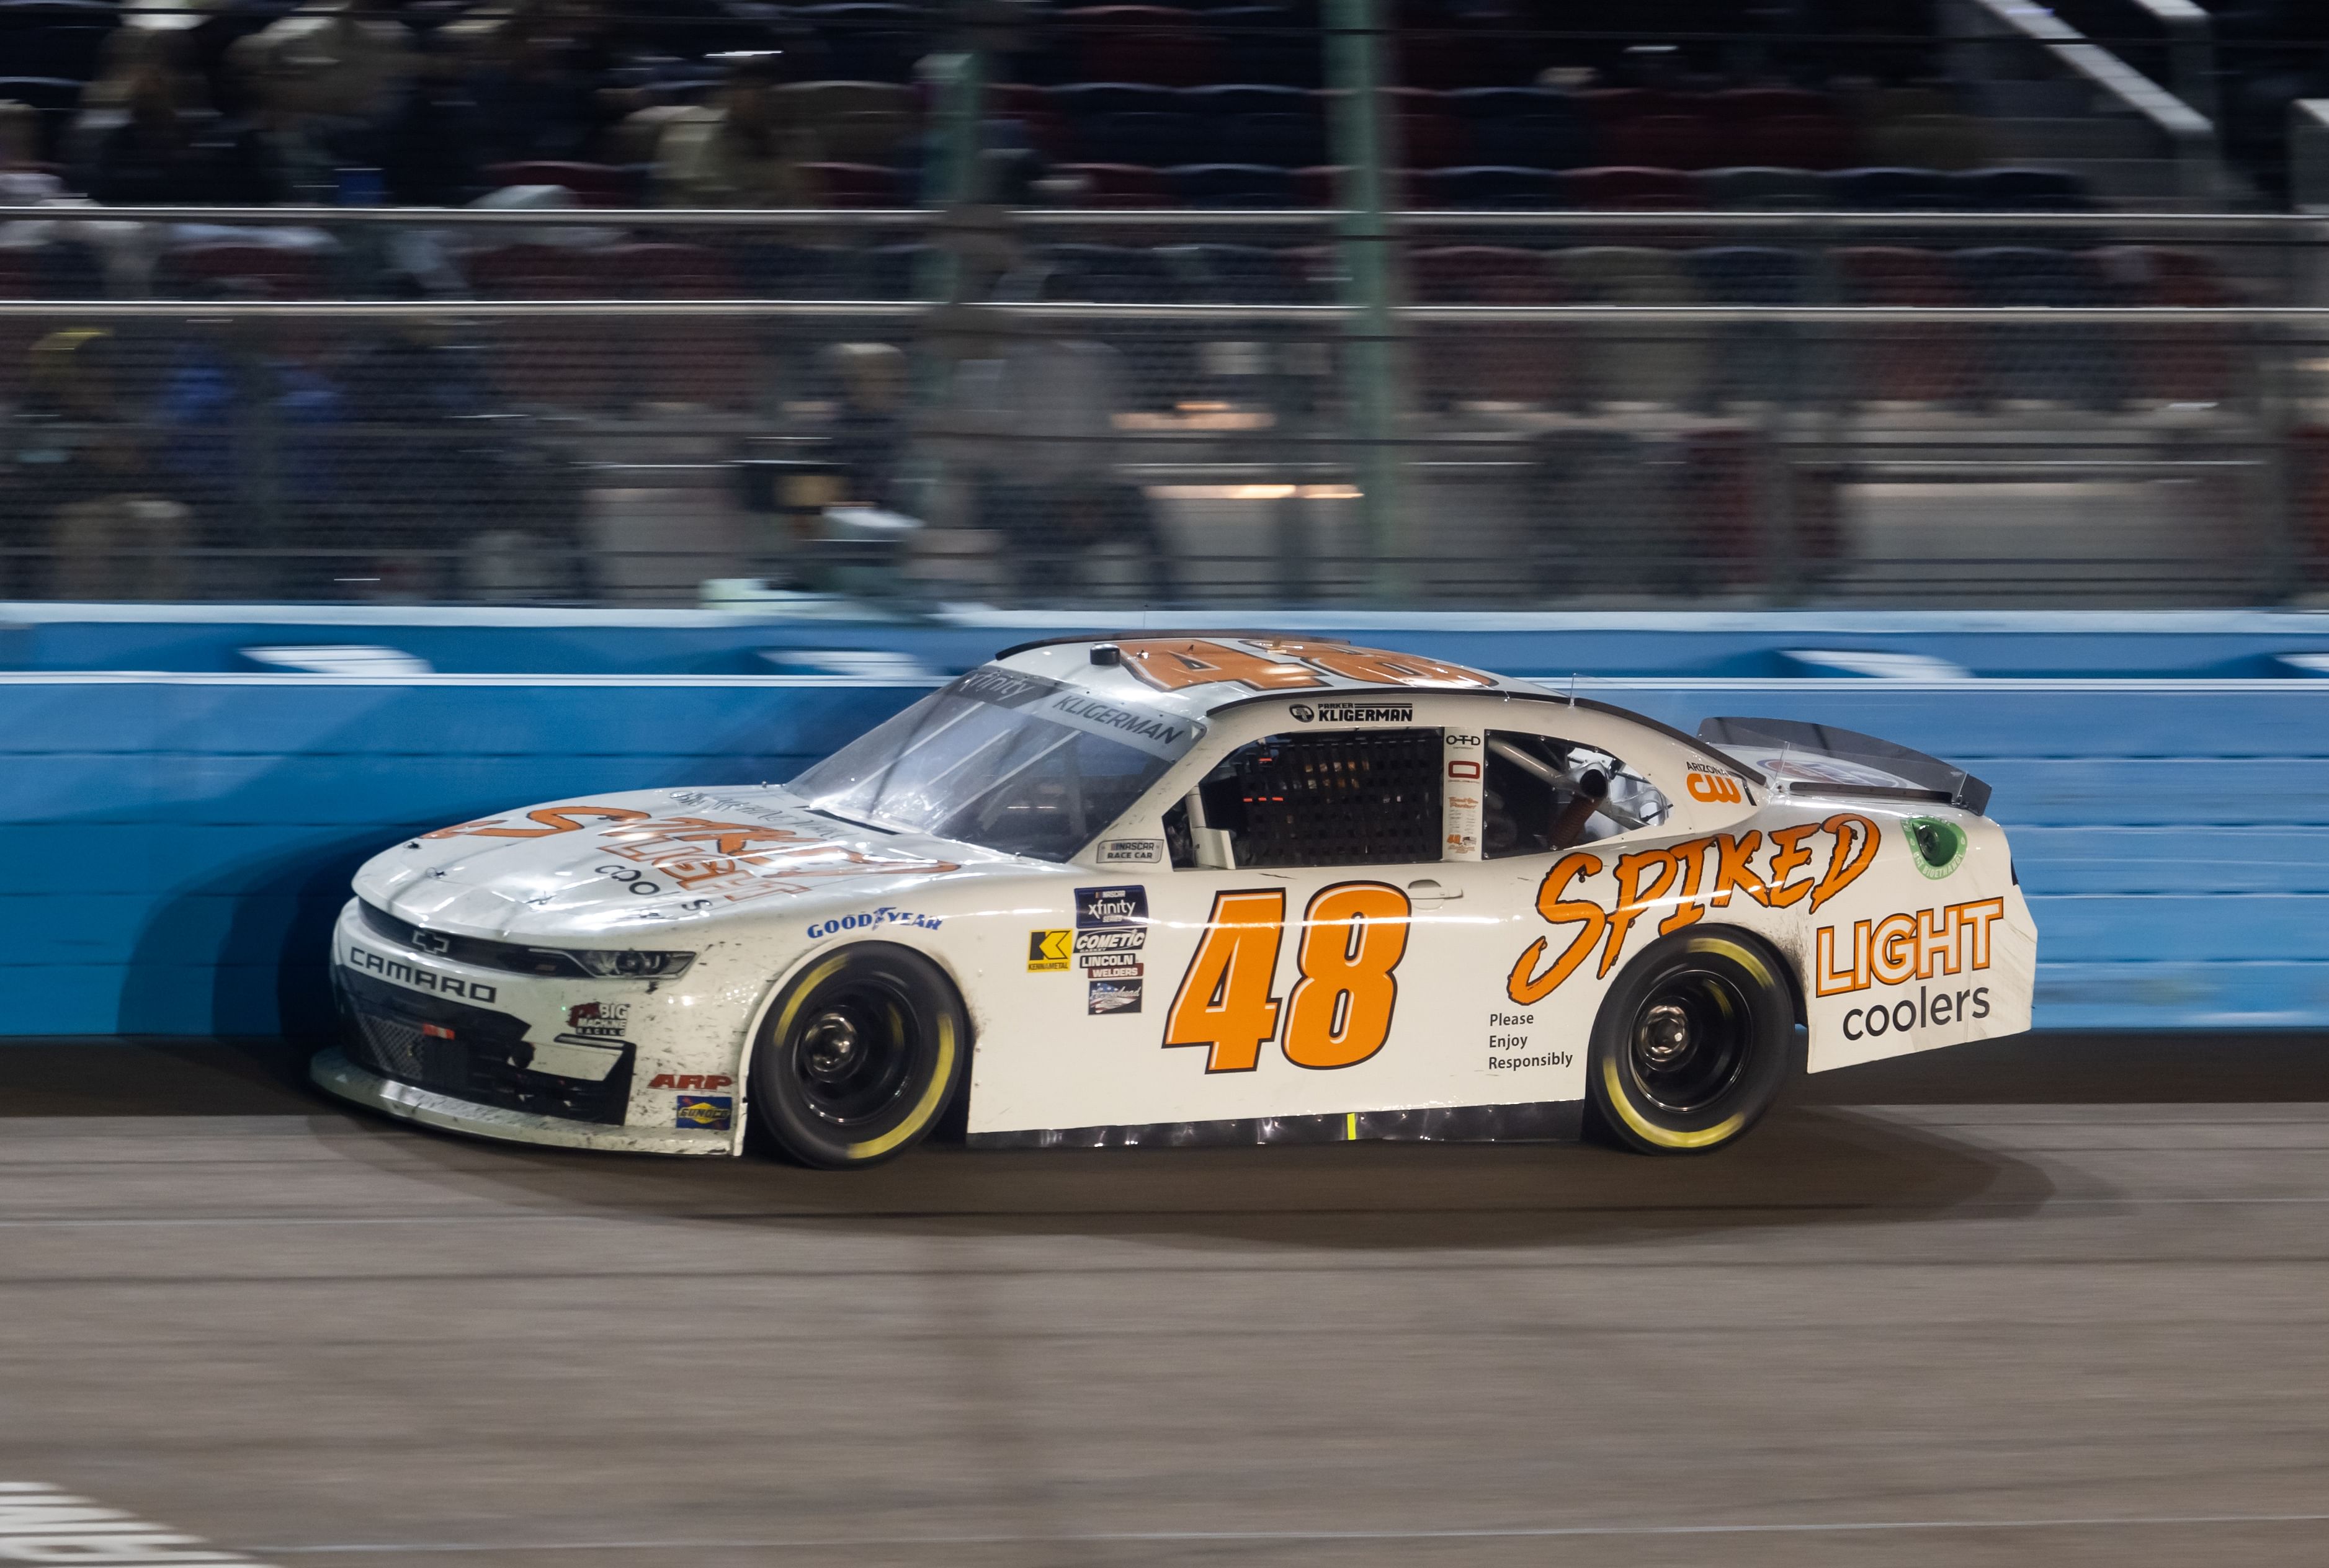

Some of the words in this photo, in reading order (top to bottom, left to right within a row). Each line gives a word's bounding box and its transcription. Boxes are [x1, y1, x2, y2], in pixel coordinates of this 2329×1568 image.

[1052, 695, 1186, 745] KLIGERMAN
[1318, 709, 1413, 721] KLIGERMAN
[1686, 761, 1728, 775] ARIZONA
[1119, 842, 1155, 850] NASCAR
[1088, 899, 1135, 919] xfinity
[1508, 813, 1882, 1005] SPIKED
[1076, 929, 1145, 950] COMETIC
[1816, 896, 2004, 998] LIGHT
[1029, 962, 1068, 970] KENNAMETAL
[1081, 955, 1134, 967] LINCOLN
[351, 946, 497, 1004] CAMARO
[1093, 968, 1138, 978] WELDERS
[1161, 880, 1411, 1074] 48
[599, 1004, 627, 1019] BIG
[1490, 1013, 1534, 1027] Please
[1842, 985, 1990, 1041] coolers
[576, 1027, 626, 1036] RACING
[1490, 1034, 1528, 1051] Enjoy
[1489, 1051, 1573, 1071] Responsibly
[646, 1074, 733, 1091] ARP
[679, 1108, 731, 1118] SUNOCO
